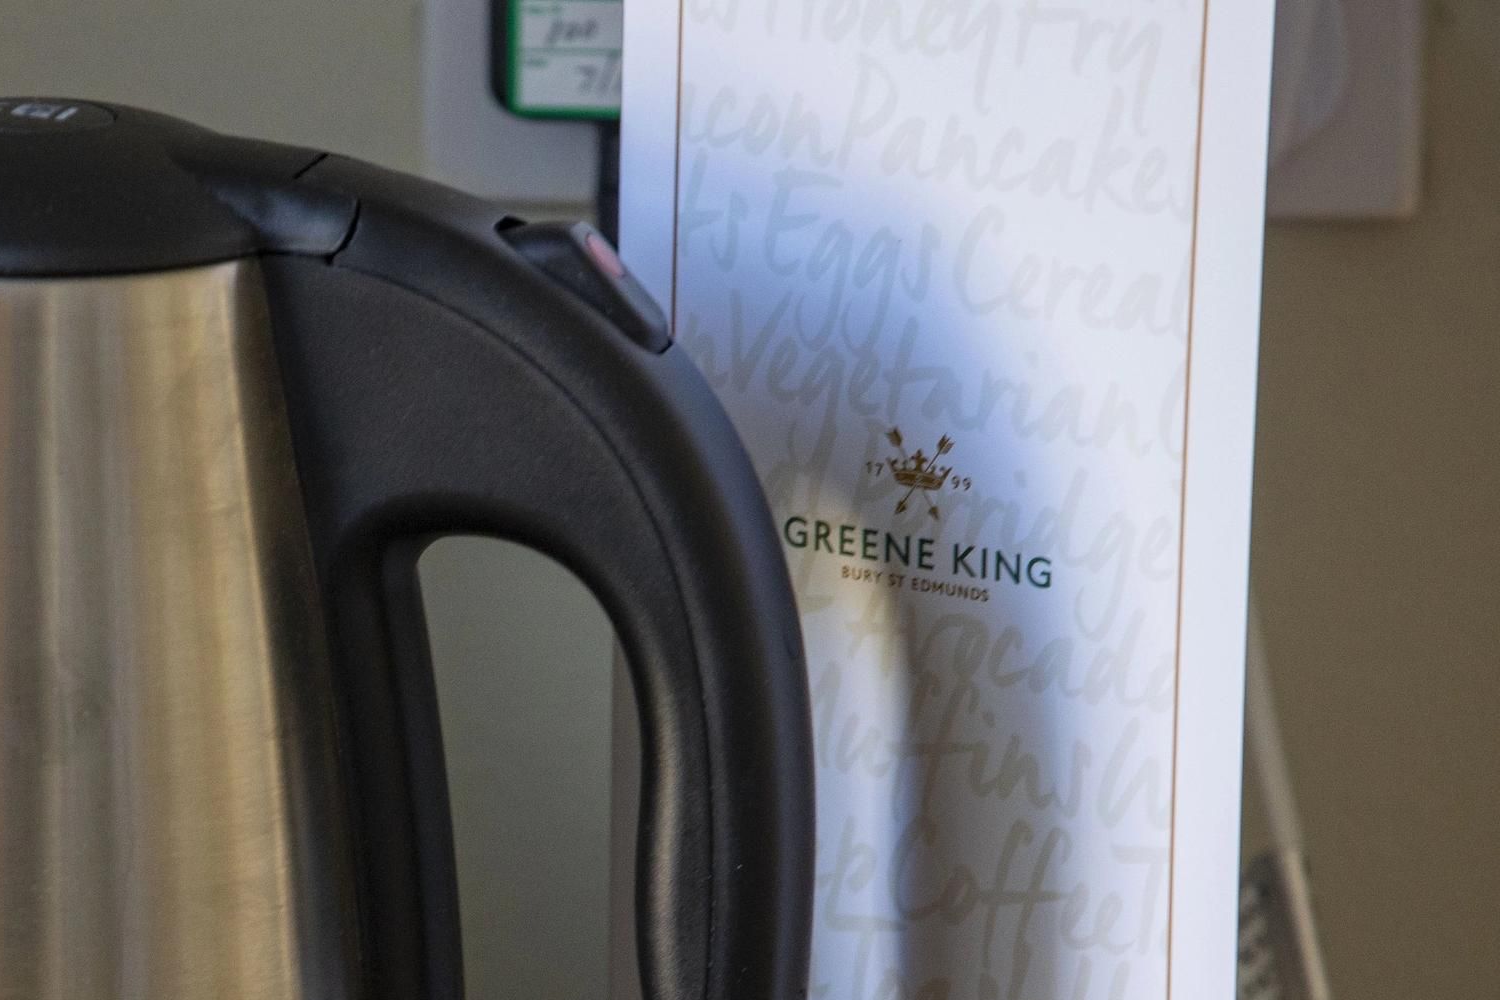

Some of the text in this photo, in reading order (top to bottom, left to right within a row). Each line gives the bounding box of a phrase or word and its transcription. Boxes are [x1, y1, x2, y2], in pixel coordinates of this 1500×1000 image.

[783, 516, 1053, 589] GREENE KING
[841, 565, 990, 602] BURY ST EDMUNDS
